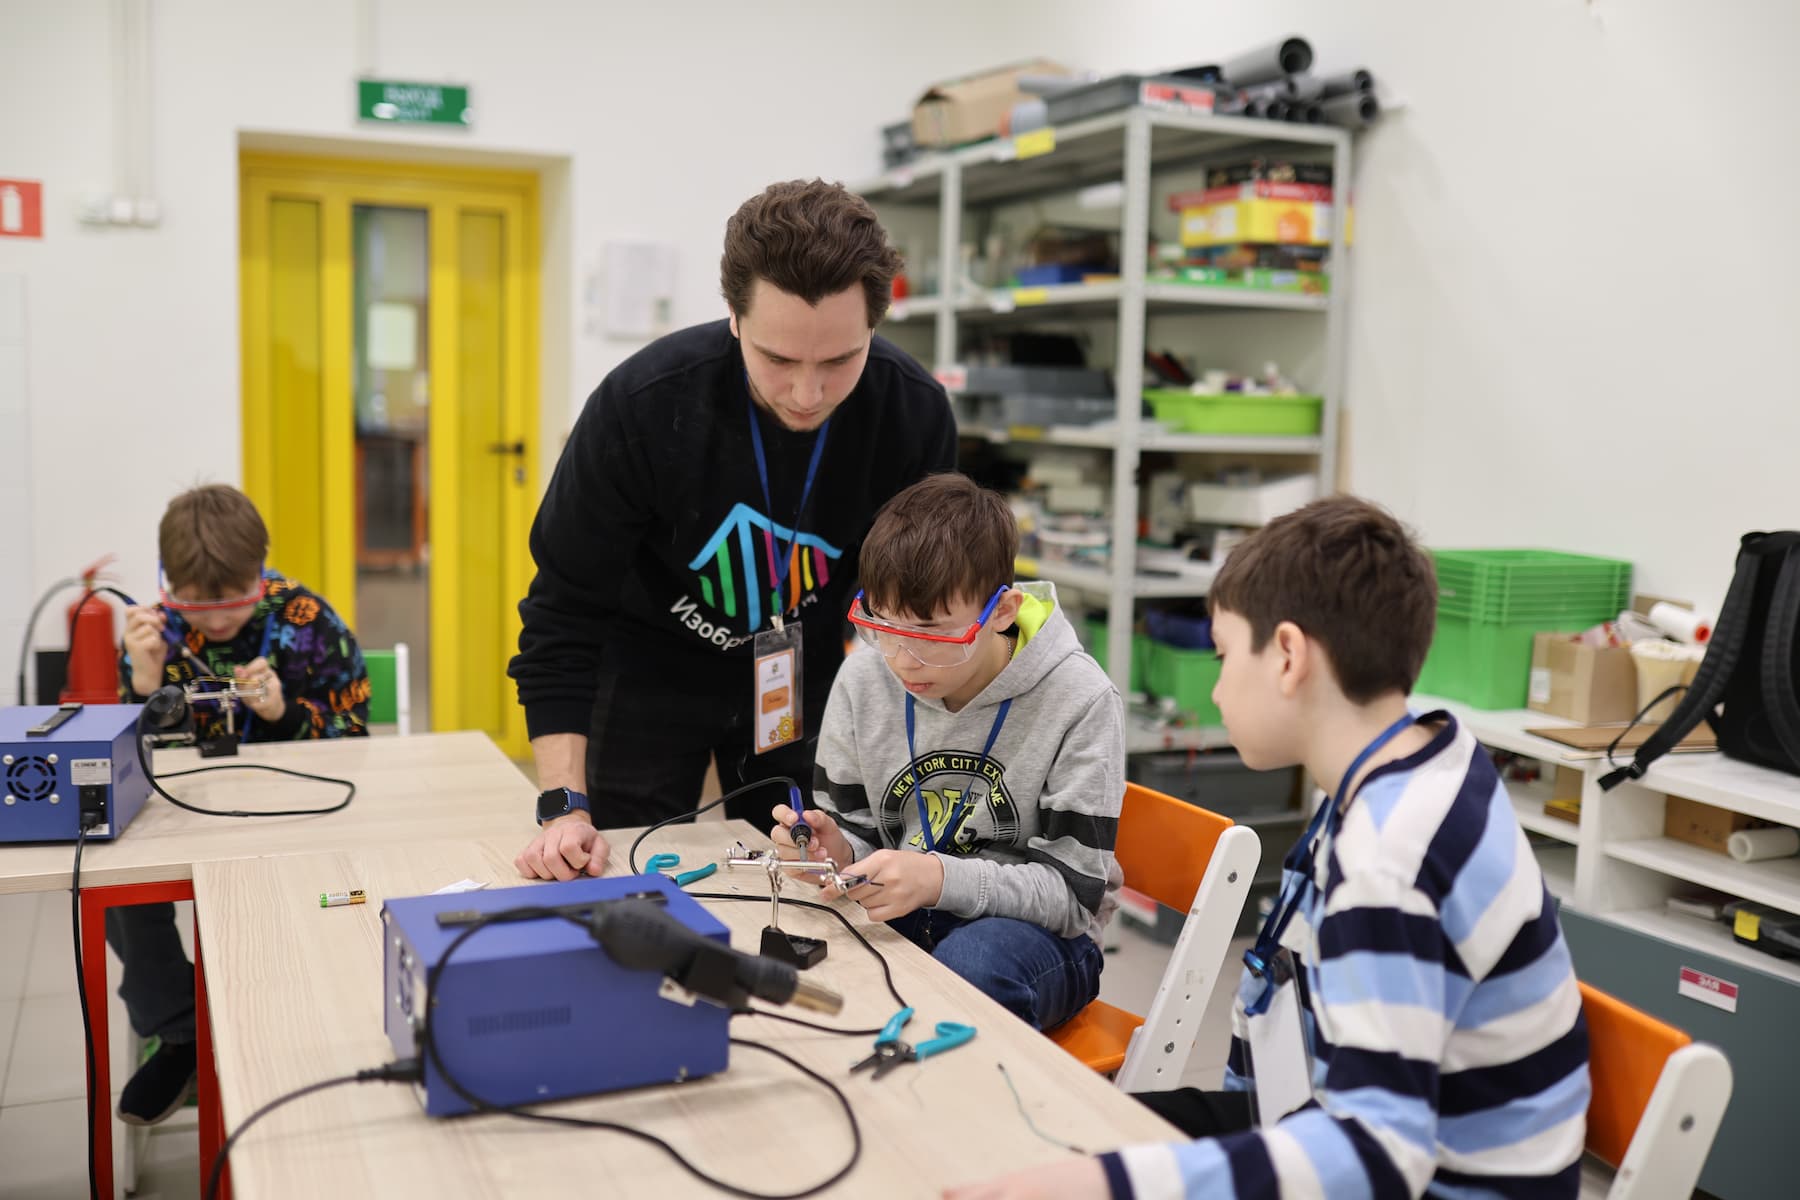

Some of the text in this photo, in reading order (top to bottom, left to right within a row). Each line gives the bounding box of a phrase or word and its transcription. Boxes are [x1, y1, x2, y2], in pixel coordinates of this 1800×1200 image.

[670, 595, 754, 651] Изобр
[892, 772, 915, 798] NEW
[916, 757, 947, 776] YORK
[951, 757, 980, 771] CITY
